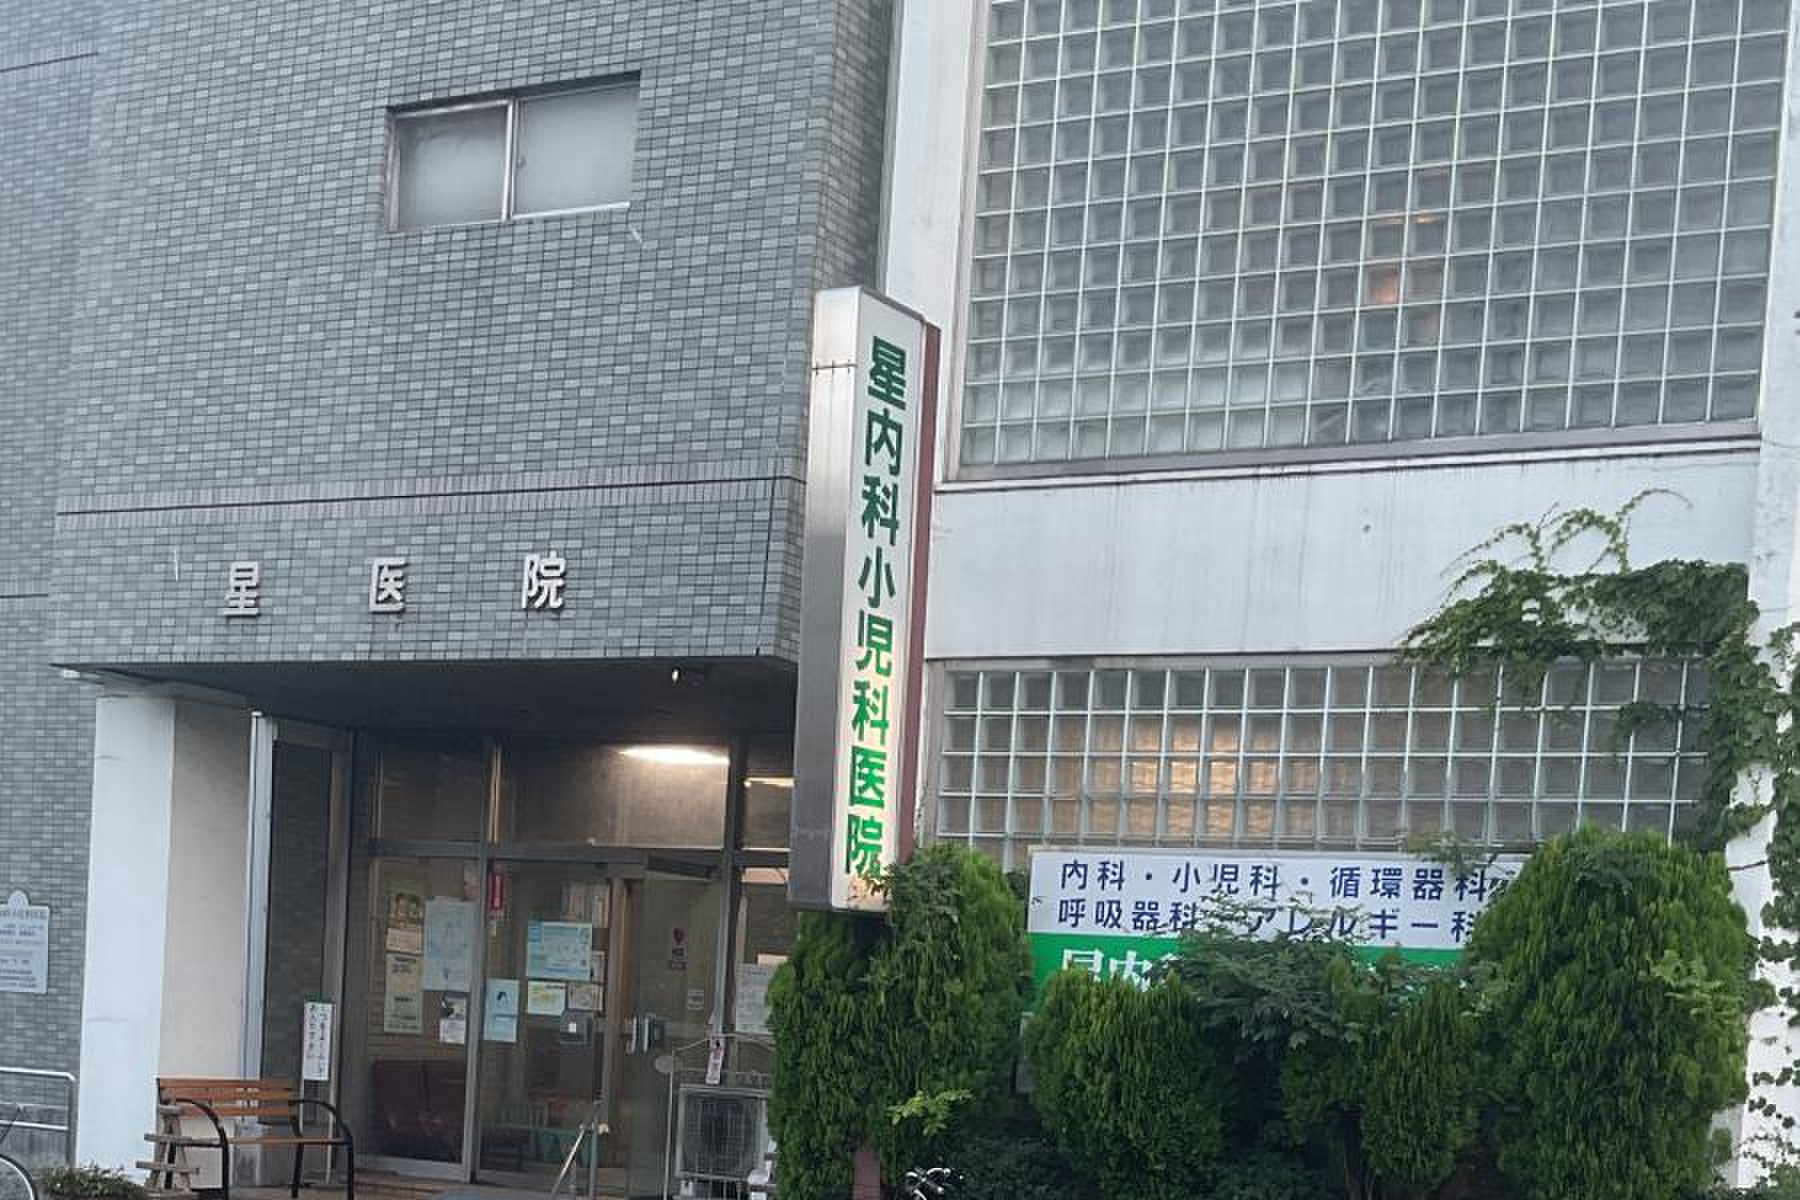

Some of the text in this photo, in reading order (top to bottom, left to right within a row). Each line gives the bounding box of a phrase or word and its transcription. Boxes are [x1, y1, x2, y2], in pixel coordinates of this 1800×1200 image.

[223, 549, 567, 616] 星医院
[845, 336, 906, 878] 星内科小児科医院
[1058, 898, 1475, 943] 呼吸器科アレルギー科
